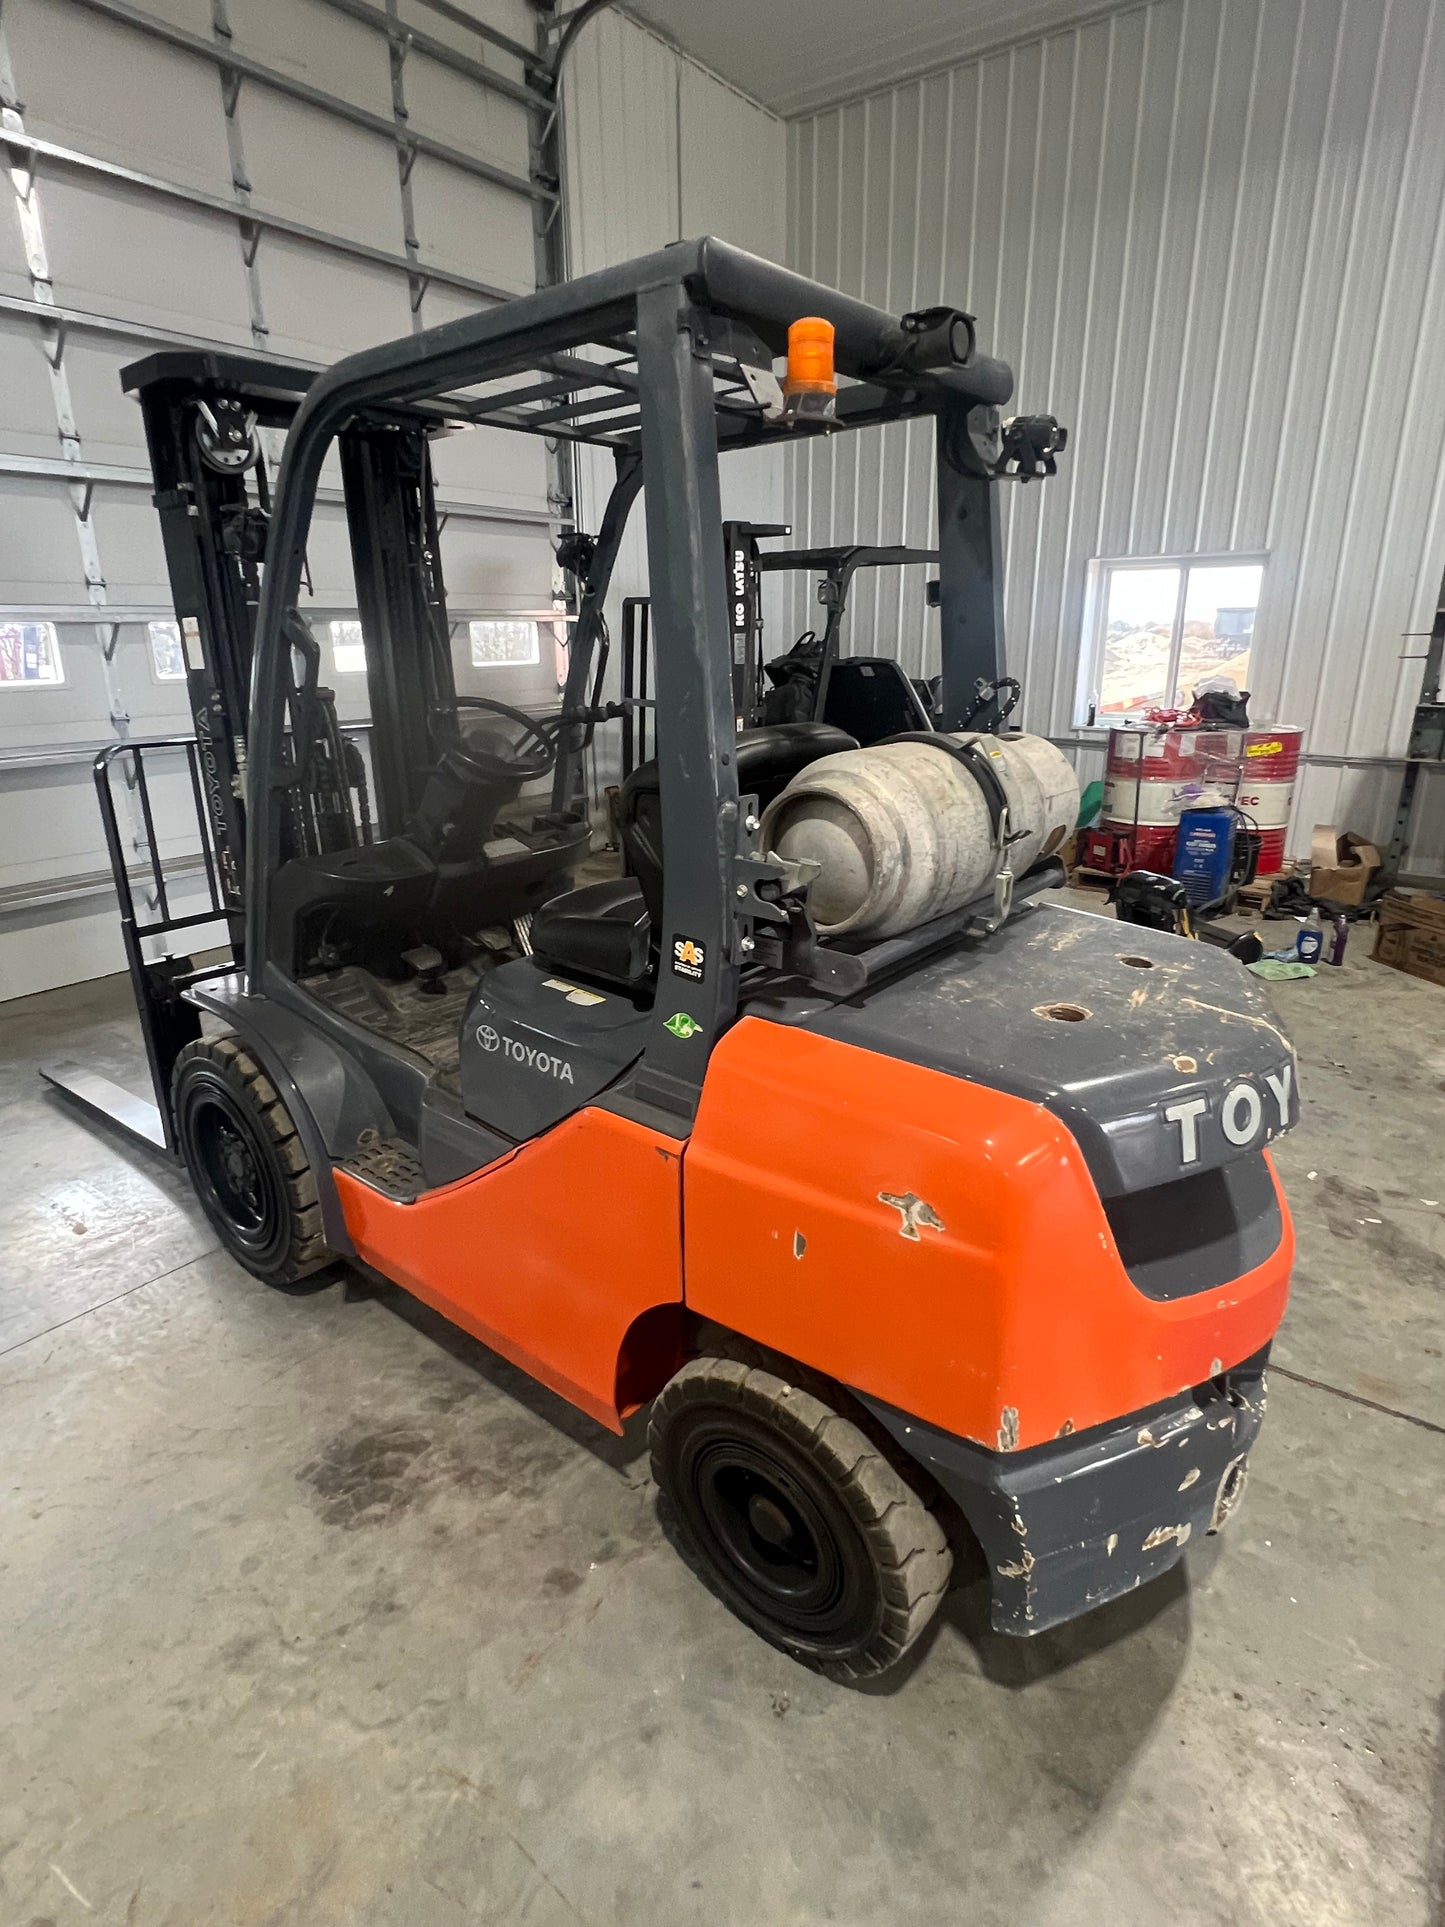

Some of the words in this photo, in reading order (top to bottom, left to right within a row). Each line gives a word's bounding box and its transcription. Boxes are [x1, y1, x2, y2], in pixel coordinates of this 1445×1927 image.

[196, 706, 228, 836] TOYOTA
[674, 941, 704, 966] SAS
[502, 1036, 574, 1084] TOYOTA
[1165, 1065, 1291, 1163] TOY
